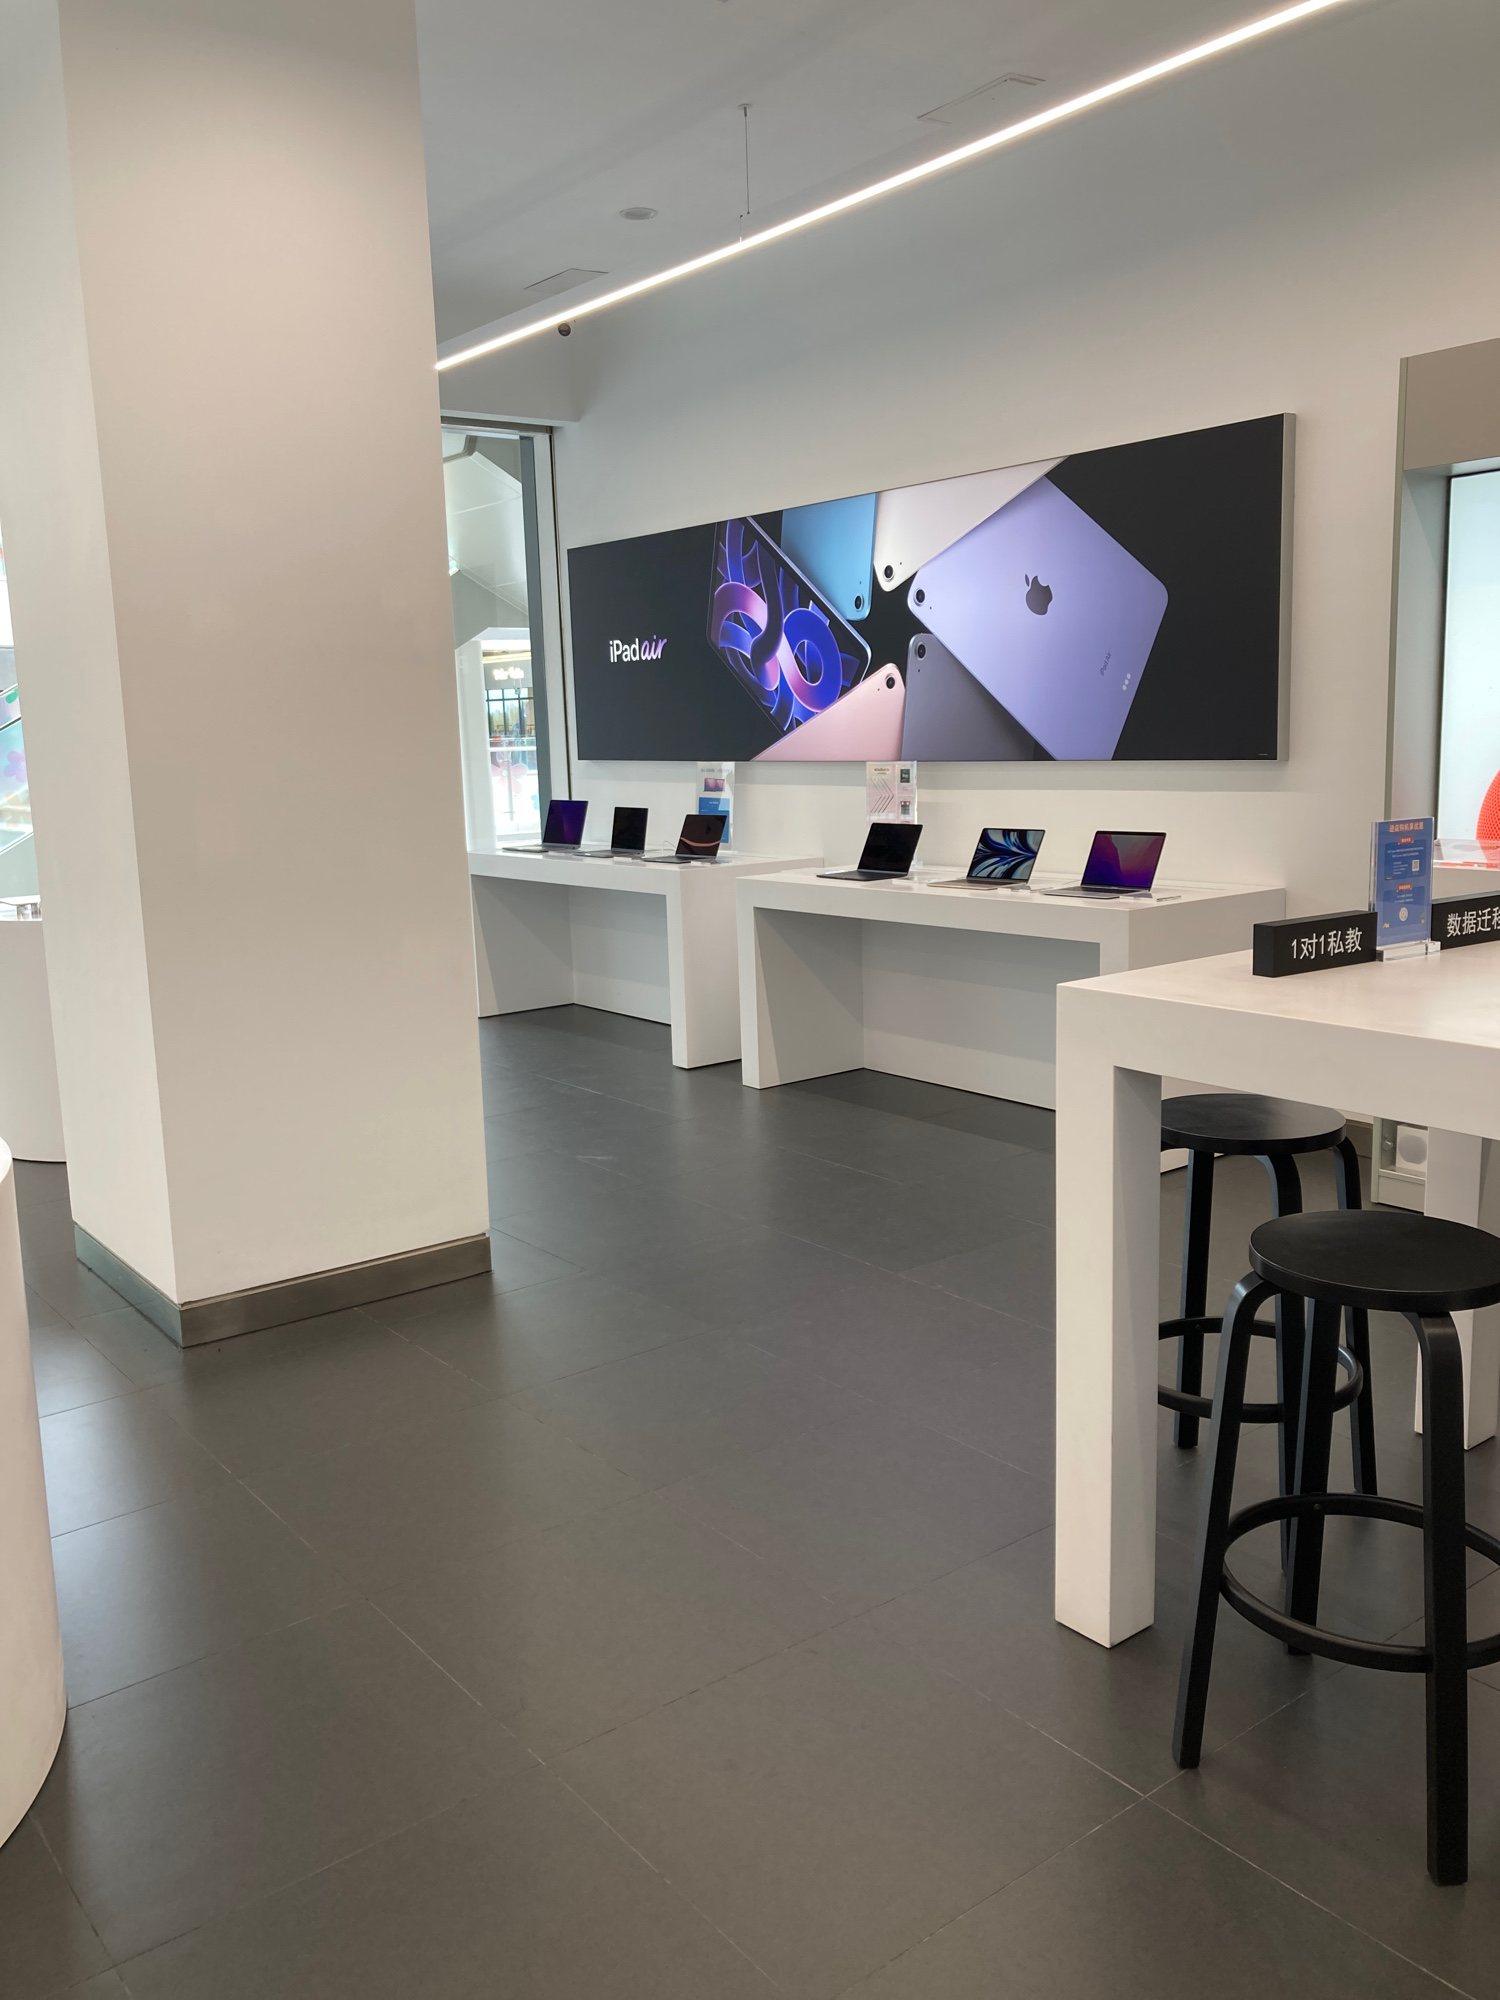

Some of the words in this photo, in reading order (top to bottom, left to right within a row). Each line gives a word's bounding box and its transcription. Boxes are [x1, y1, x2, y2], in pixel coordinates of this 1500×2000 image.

[610, 638, 640, 663] iPad
[641, 635, 668, 661] air
[1291, 926, 1363, 960] 1对1私教
